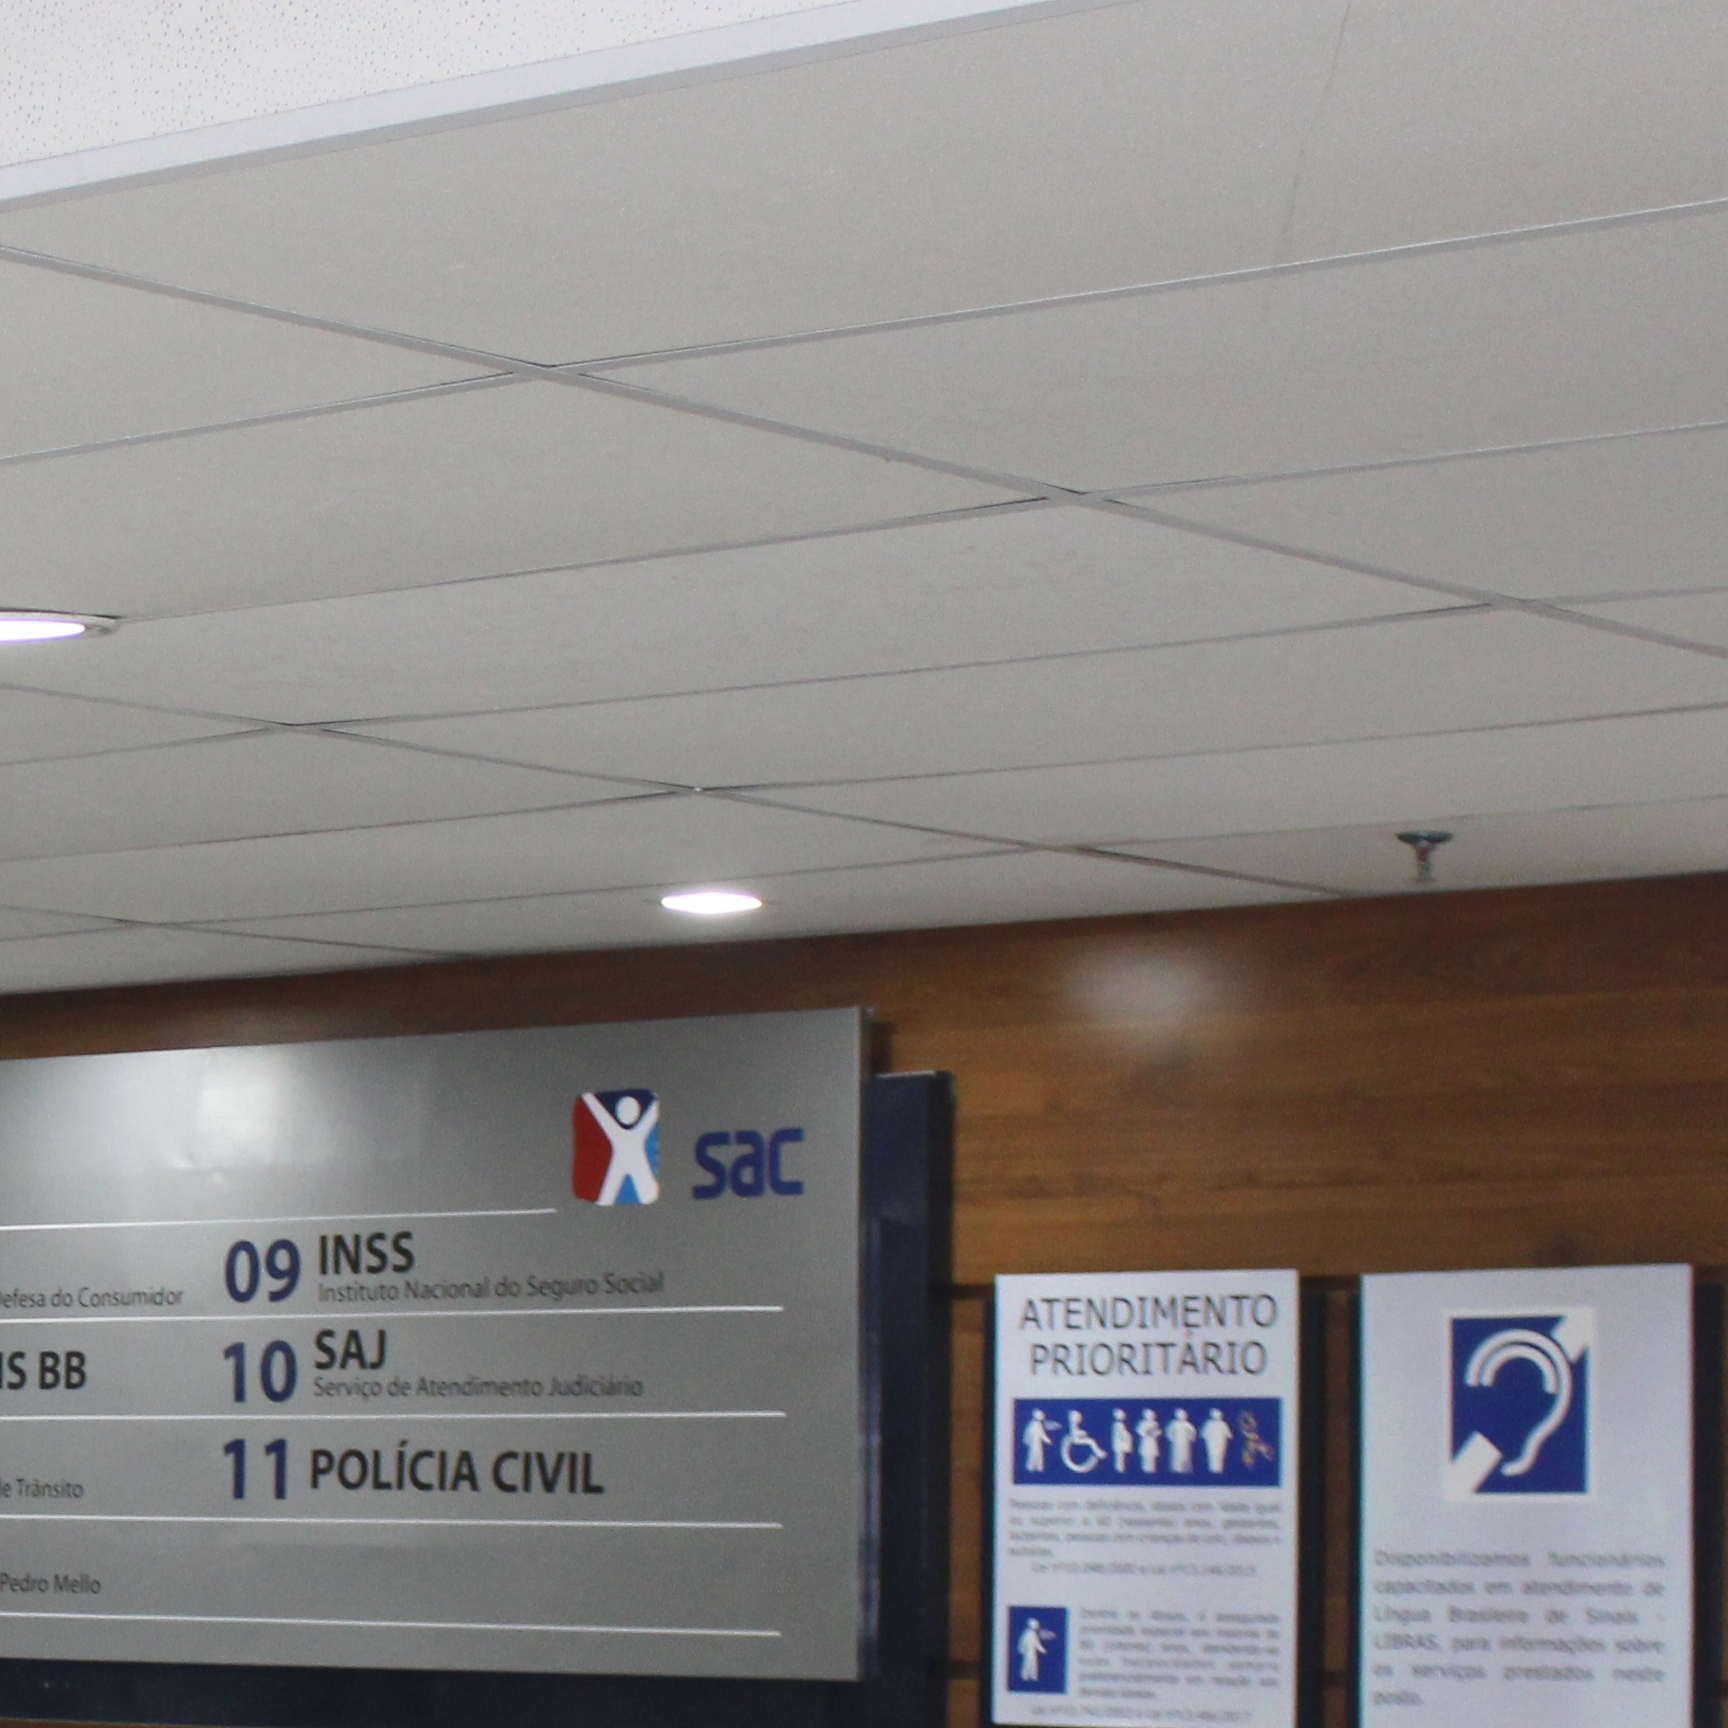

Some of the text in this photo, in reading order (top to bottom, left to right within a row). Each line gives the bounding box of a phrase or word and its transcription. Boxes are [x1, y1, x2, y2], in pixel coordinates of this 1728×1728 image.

[692, 1128, 804, 1199] sac
[225, 1238, 301, 1303] 09
[319, 1232, 414, 1275] INSS
[50, 1287, 74, 1308] do
[77, 1286, 183, 1308] Consumidor
[319, 1271, 664, 1303] Instituto Nacional do Seguro Social
[1020, 1294, 1277, 1330] ATENDIMENTO
[39, 1350, 87, 1390] BB
[314, 1329, 387, 1370] SAJ
[1030, 1332, 1268, 1375] PRIORITÁRIO
[223, 1340, 297, 1403] 10
[314, 1374, 643, 1399] Serviço de Atendimento Judiciário
[223, 1438, 288, 1500] 11
[311, 1440, 604, 1494] POLÍCIA CIVIL
[16, 1478, 84, 1498] Trânsito
[0, 1572, 49, 1594] Pedro
[53, 1573, 101, 1594] Mello
